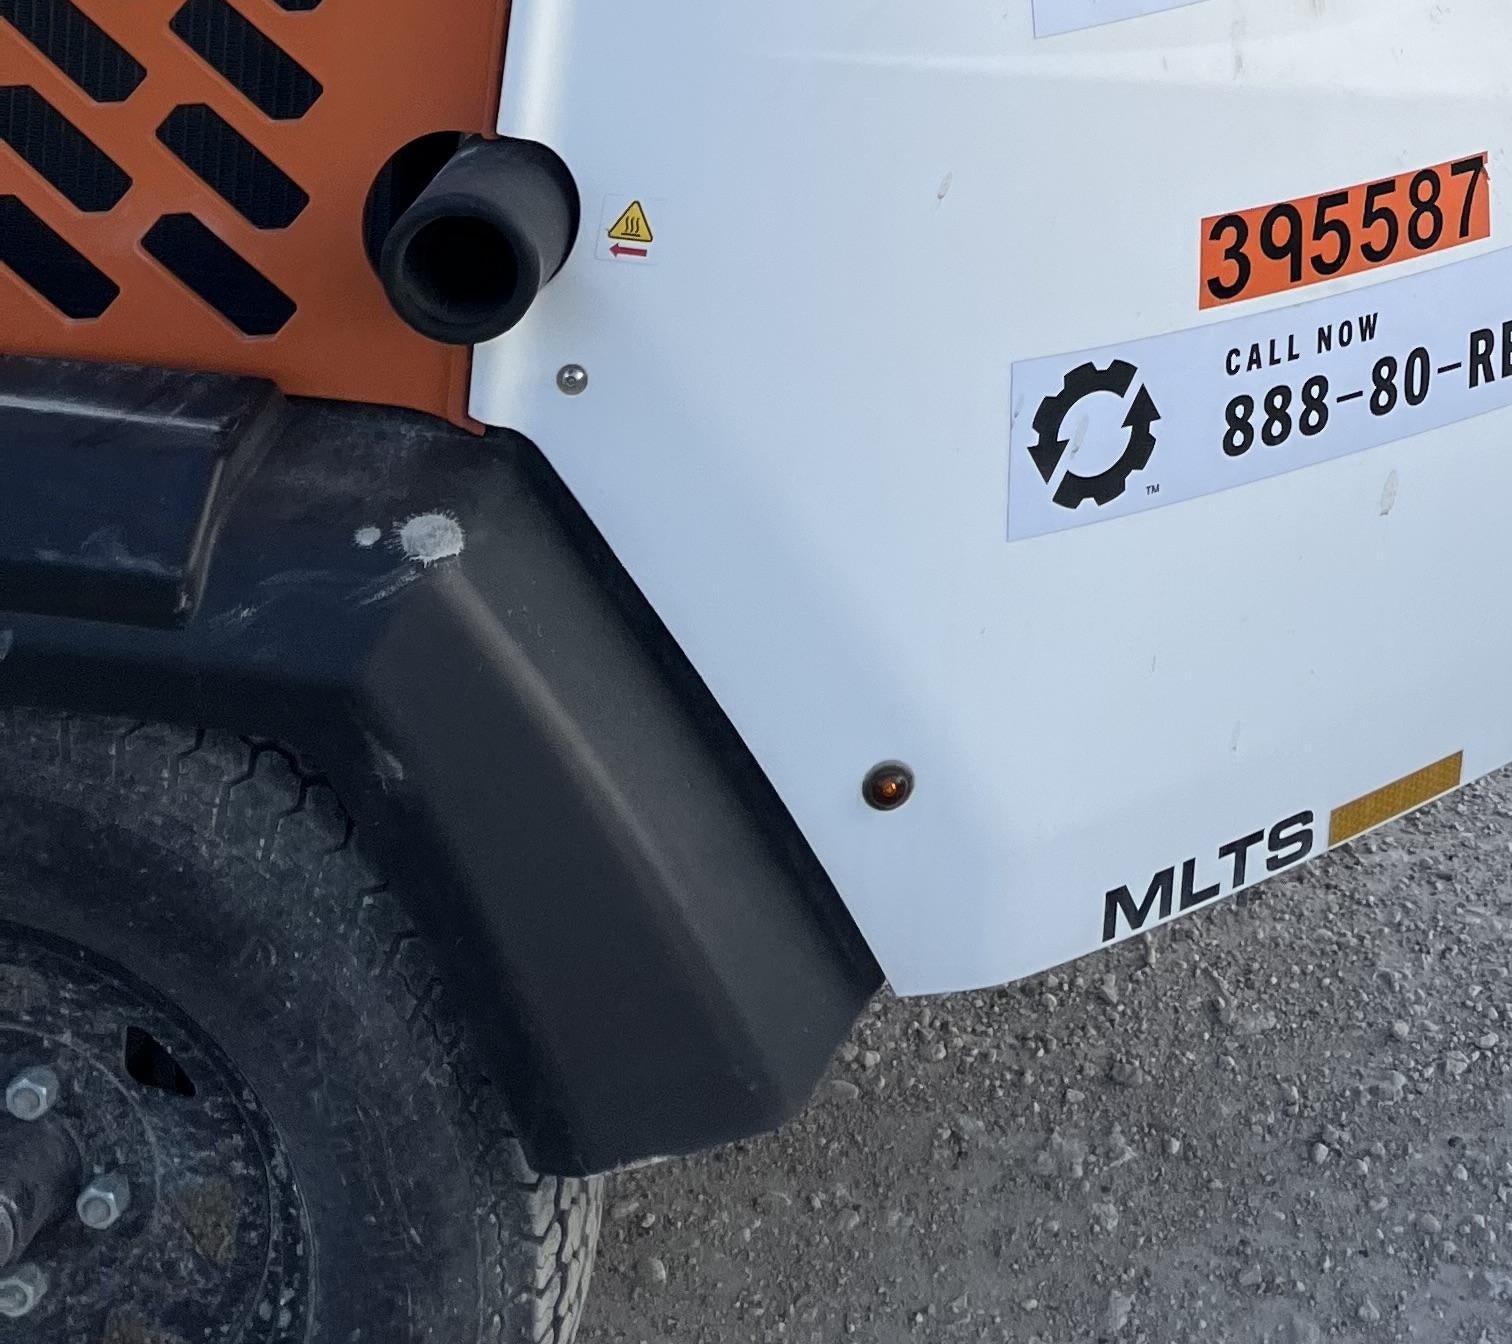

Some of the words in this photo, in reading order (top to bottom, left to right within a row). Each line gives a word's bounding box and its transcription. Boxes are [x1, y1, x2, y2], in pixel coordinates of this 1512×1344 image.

[1207, 156, 1485, 300] 395587
[1225, 334, 1301, 377] CALL
[1317, 313, 1379, 354] NOW
[1102, 810, 1314, 943] MLTS
